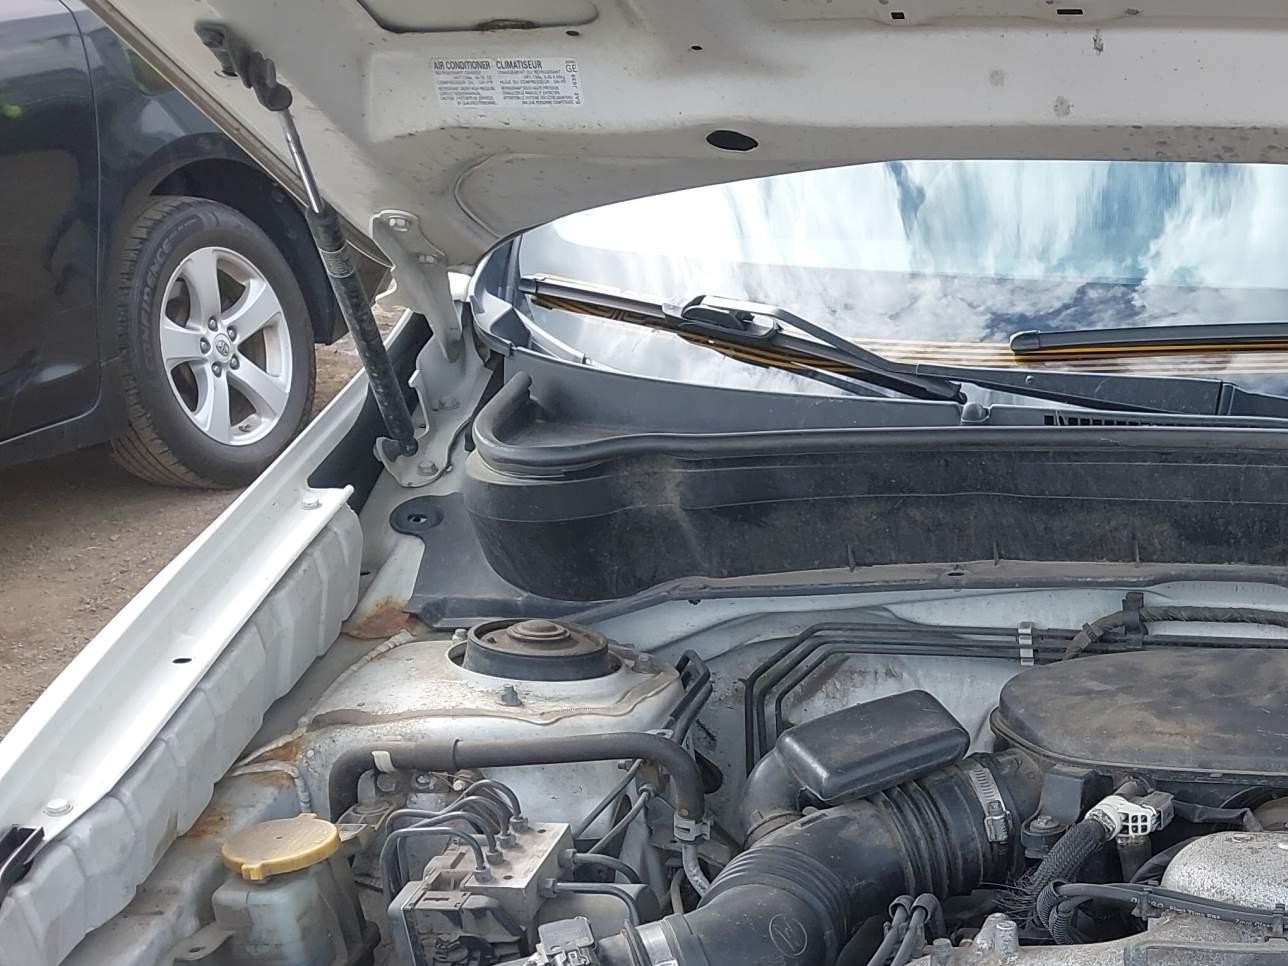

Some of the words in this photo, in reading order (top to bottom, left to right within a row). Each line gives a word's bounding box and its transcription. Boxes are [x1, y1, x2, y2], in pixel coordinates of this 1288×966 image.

[434, 60, 445, 70] AIR
[446, 60, 491, 70] CONDITIONER
[496, 60, 543, 70] CLIMATISEUR
